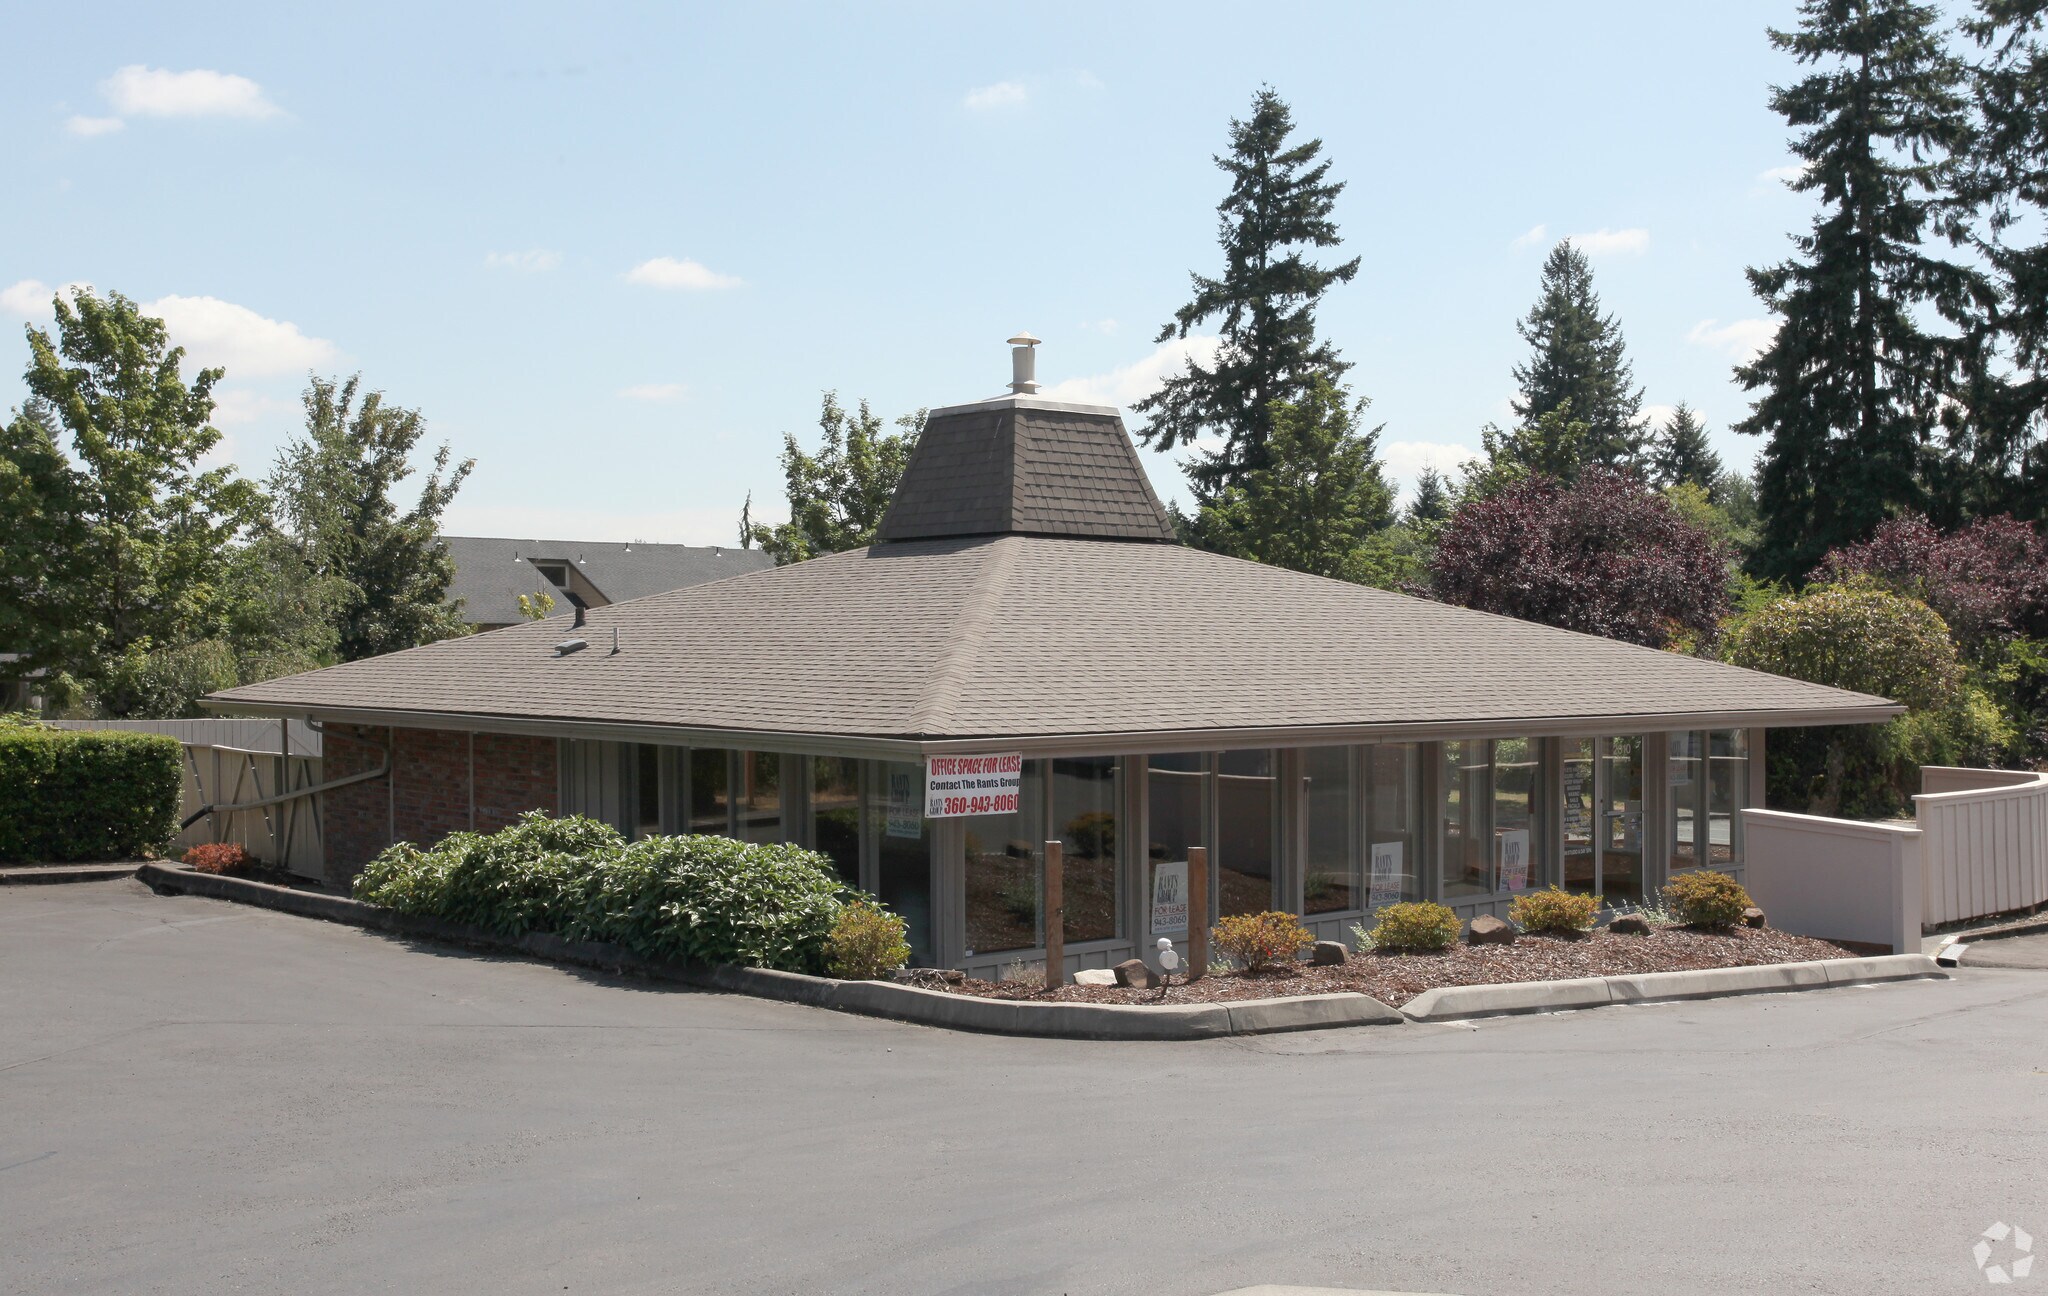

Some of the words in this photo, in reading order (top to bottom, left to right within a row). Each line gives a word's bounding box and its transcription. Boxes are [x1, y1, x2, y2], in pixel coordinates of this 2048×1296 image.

[1613, 744, 1631, 754] 2810
[931, 758, 957, 775] OFFICE
[957, 757, 981, 774] SPACE
[982, 757, 998, 773] FOR
[999, 755, 1021, 772] LEASE
[930, 780, 961, 790] Contact
[962, 780, 975, 789] The
[976, 778, 999, 789] Rants
[1000, 777, 1020, 788] Group
[944, 794, 1019, 814] 360-943-8060
[1372, 883, 1384, 891] FOR
[1384, 881, 1400, 890] LEASE
[1371, 892, 1400, 901] 943-8060
[1154, 907, 1167, 915] FOR
[1168, 904, 1187, 914] LEASE
[1154, 915, 1187, 926] 943-8060
